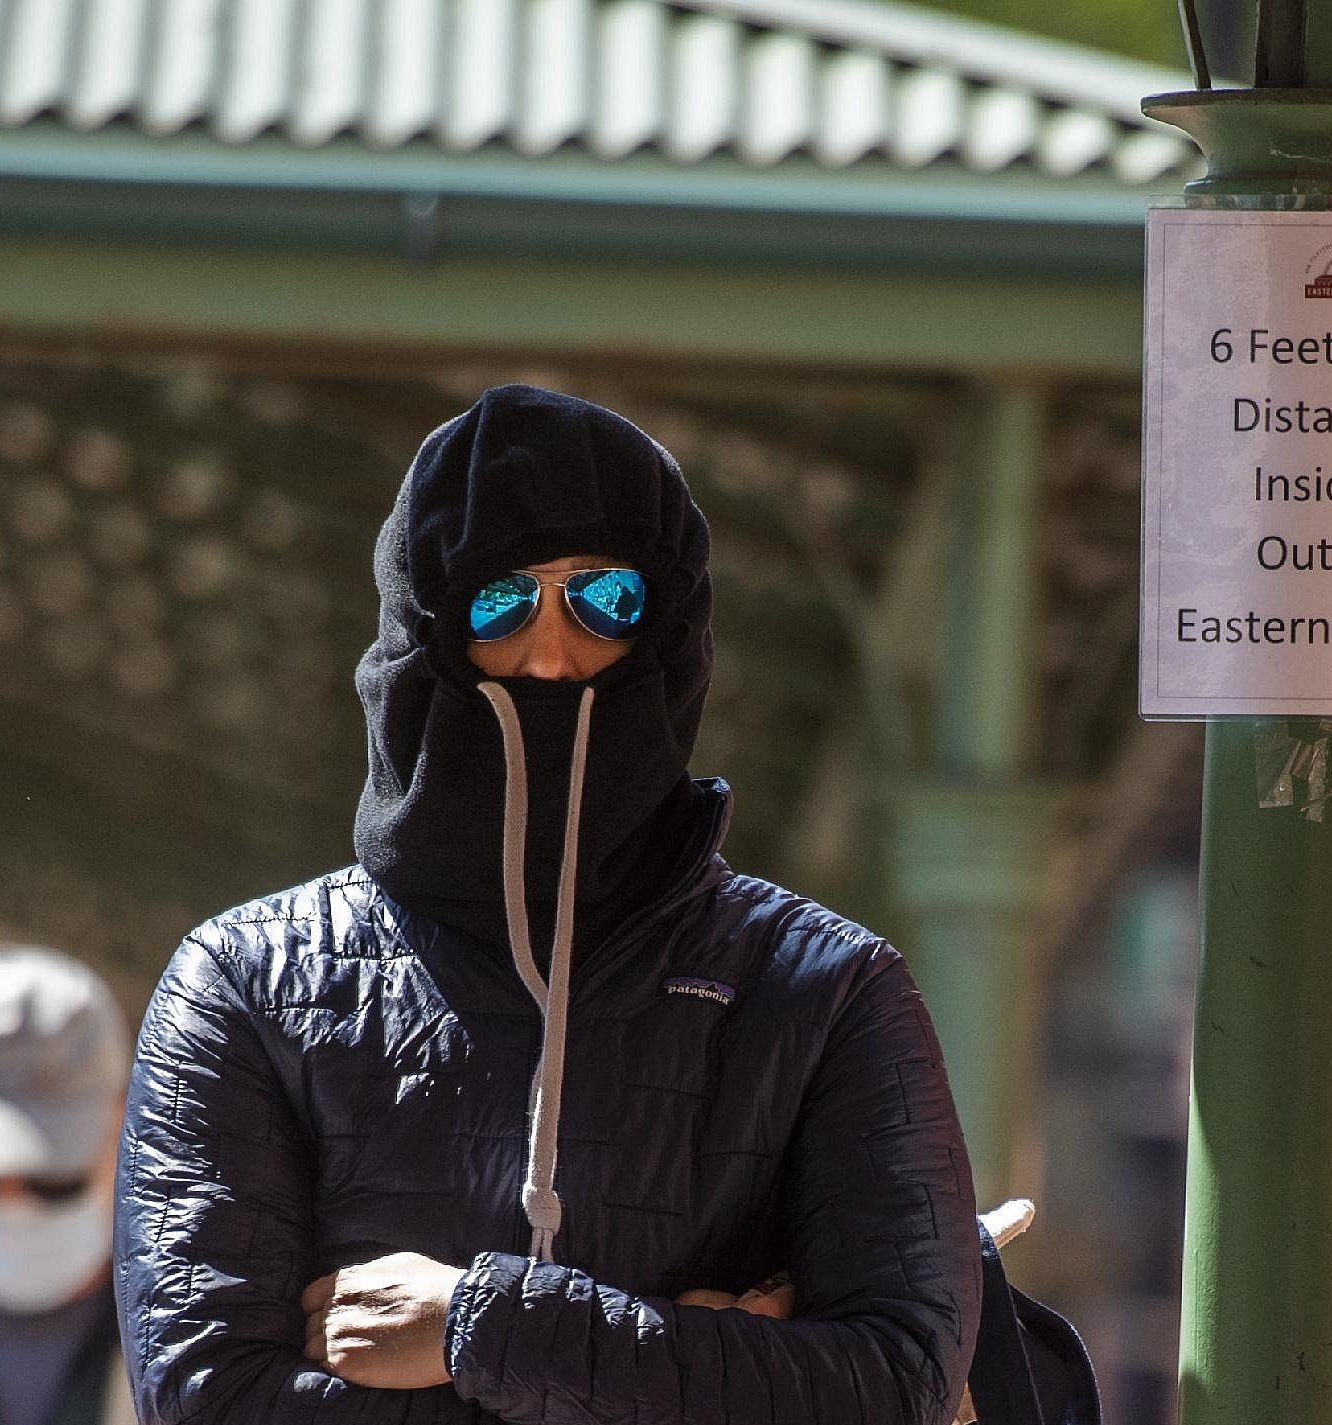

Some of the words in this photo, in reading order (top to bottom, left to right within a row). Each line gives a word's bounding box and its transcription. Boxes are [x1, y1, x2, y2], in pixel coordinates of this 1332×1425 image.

[1210, 328, 1234, 364] 6
[1177, 608, 1330, 645] Eastern
[667, 984, 731, 1005] patagonia
